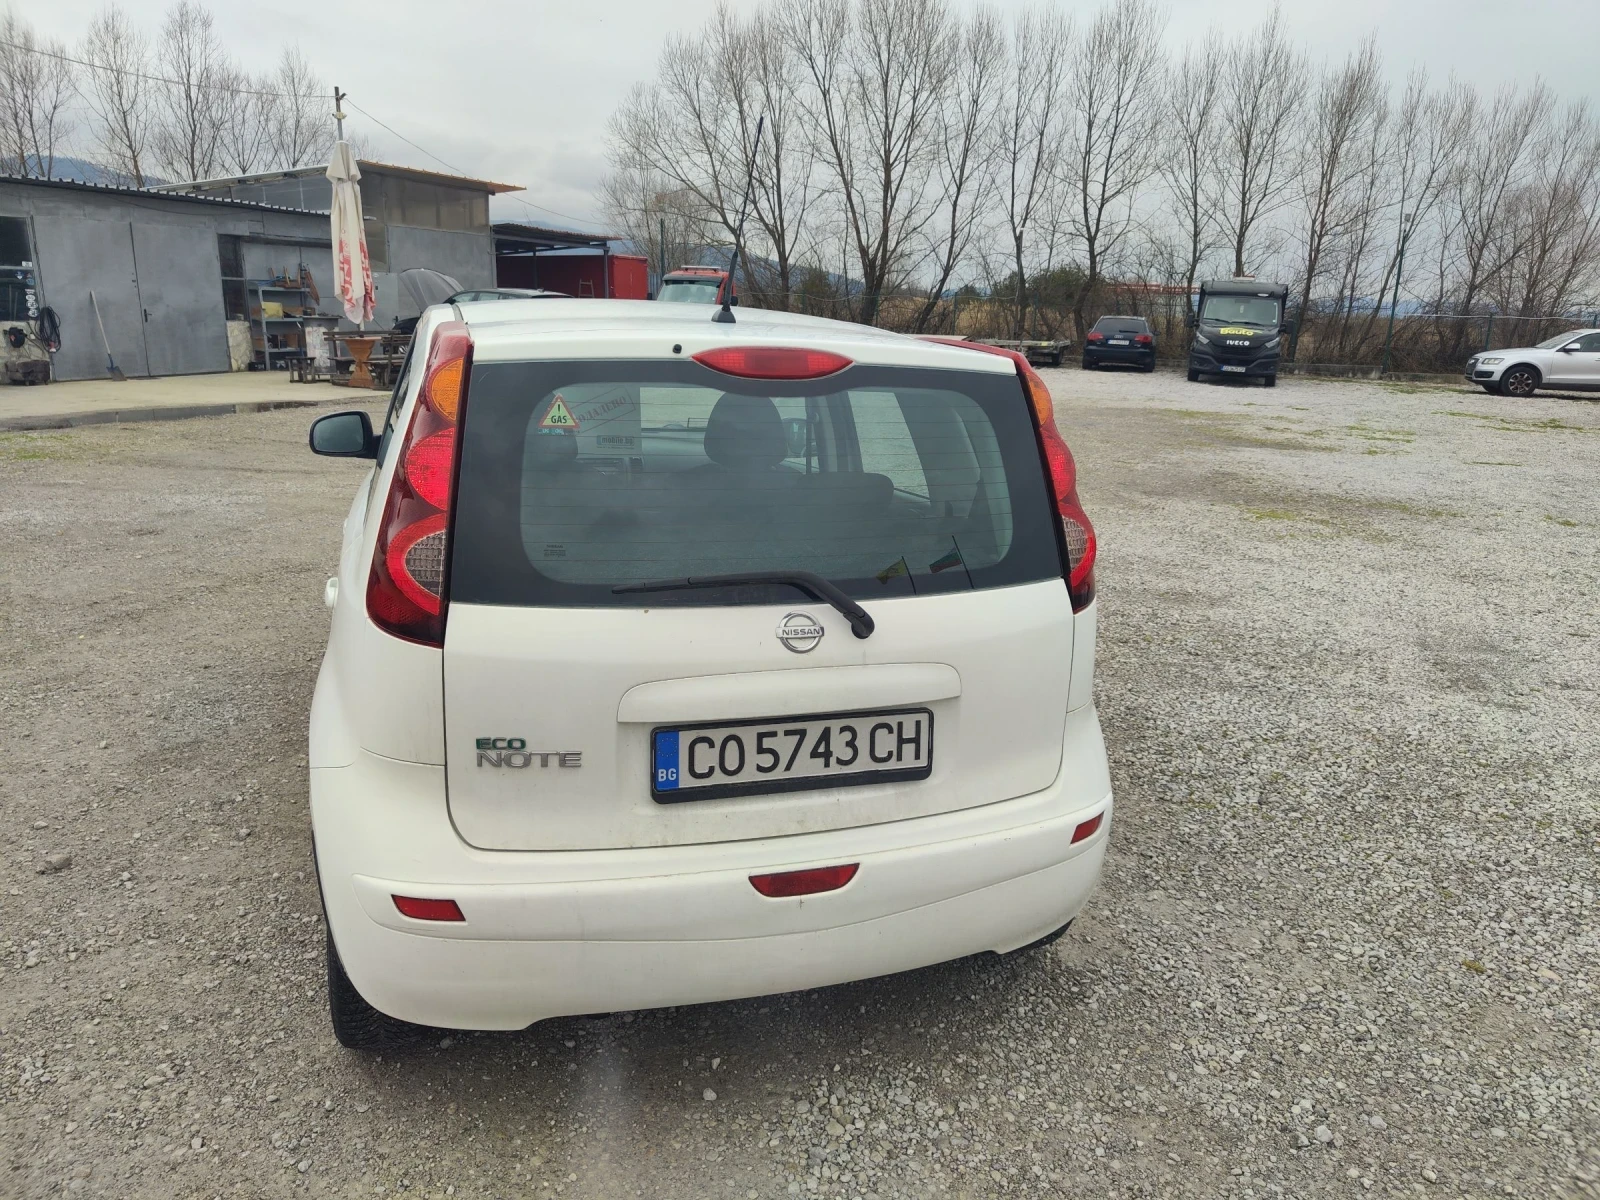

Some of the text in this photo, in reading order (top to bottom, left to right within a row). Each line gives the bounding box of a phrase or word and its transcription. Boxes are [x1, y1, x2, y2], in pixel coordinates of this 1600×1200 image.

[550, 415, 568, 424] GAS
[781, 628, 821, 637] NISSAN
[476, 737, 526, 750] ECO
[756, 724, 859, 773] 5743
[869, 719, 921, 763] CH
[476, 751, 582, 768] NOTE
[658, 768, 677, 782] BG
